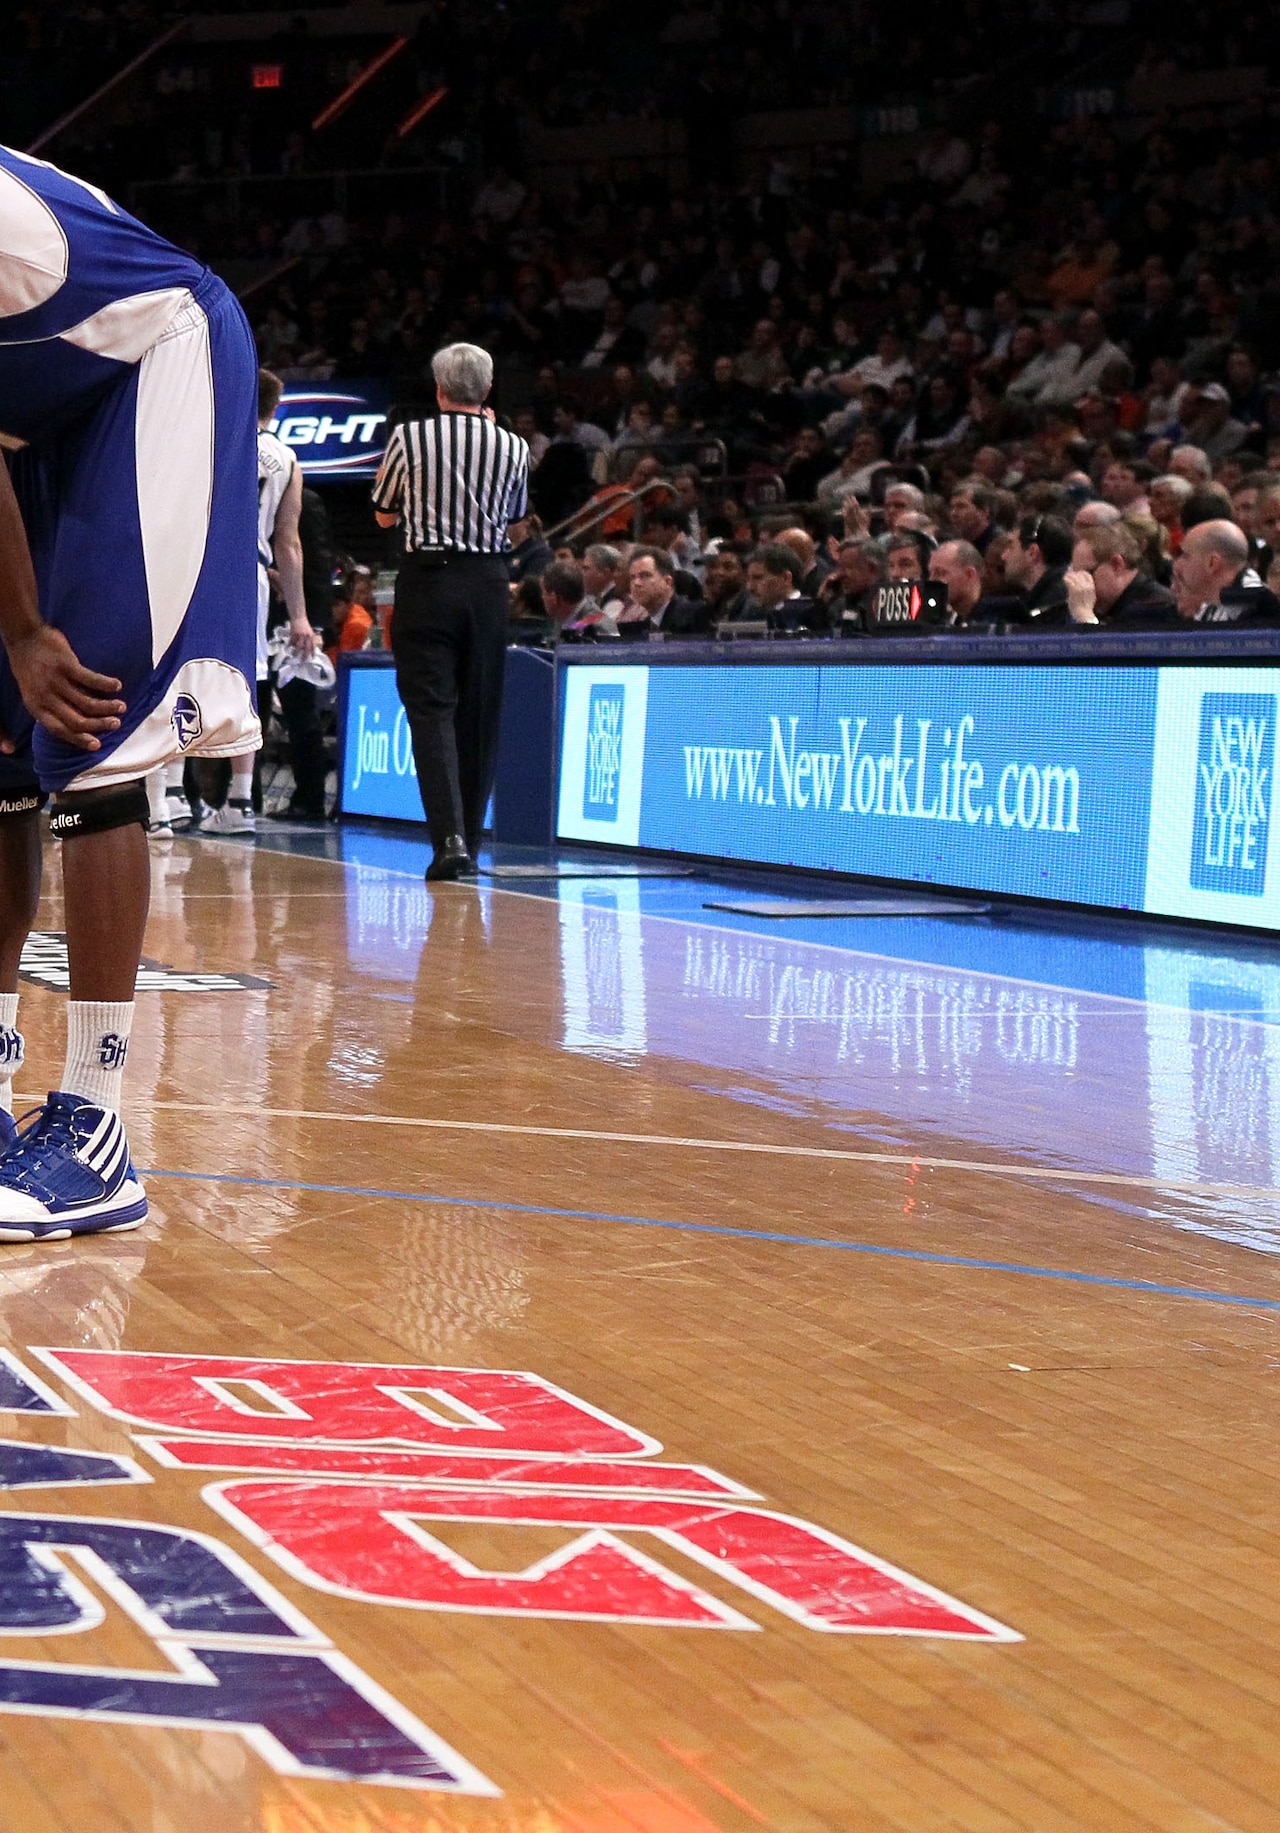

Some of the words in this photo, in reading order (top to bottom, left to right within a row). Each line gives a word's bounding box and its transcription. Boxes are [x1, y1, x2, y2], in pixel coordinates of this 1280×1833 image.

[877, 586, 910, 621] POSS
[593, 699, 620, 735] NEW
[1211, 716, 1267, 767] NEW
[352, 705, 389, 790] Join
[393, 705, 417, 777] O
[589, 732, 621, 771] YORK
[683, 714, 1081, 833] www.NewYorkLife.com
[589, 766, 615, 804] LIFE
[1201, 763, 1271, 819] YORK
[1204, 813, 1260, 870] LIFE
[26, 1346, 1026, 1642] BIG
